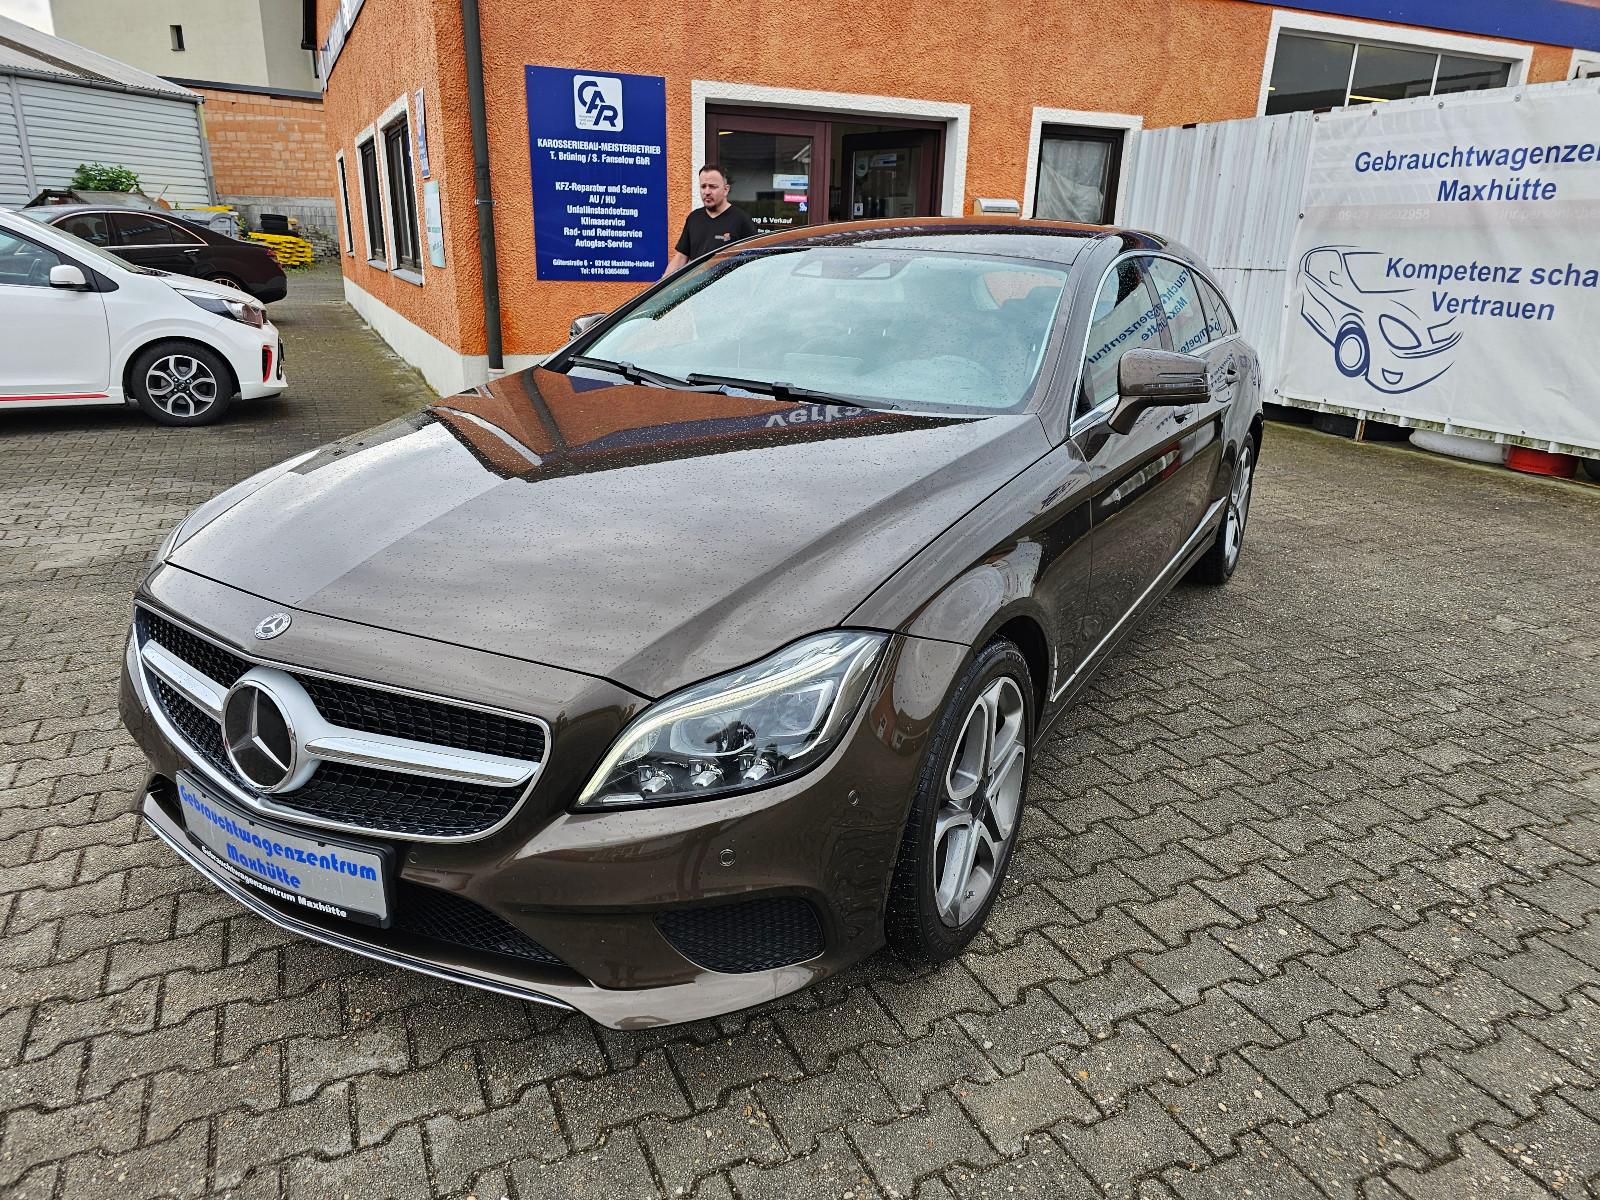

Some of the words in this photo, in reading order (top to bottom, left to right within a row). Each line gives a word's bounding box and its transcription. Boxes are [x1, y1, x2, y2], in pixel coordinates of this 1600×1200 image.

[578, 81, 618, 127] CAR
[537, 139, 661, 154] KAROSSERIEBAU-MEISTERBETRIEB
[558, 152, 586, 163] Brüning
[592, 154, 600, 163] S.
[602, 154, 634, 165] Fanselow
[635, 156, 651, 166] GbR
[1354, 143, 1600, 173] Gebrauchtwagenze
[555, 182, 606, 193] KFZ-Reparatur
[607, 184, 621, 193] und
[622, 185, 647, 194] Service
[1437, 177, 1557, 202] Maxhütte
[589, 195, 599, 203] AU
[605, 195, 616, 204] HU
[567, 205, 638, 217] Unfallinstandsetzung
[581, 217, 625, 226] Klimaservice
[769, 217, 793, 225] Verkauf
[564, 227, 580, 235] Rad-
[597, 229, 642, 238] Reifenservice
[575, 239, 632, 248] Autoglas-Service
[1385, 257, 1522, 285] Kompetenz
[1431, 291, 1556, 321] Vertrauen
[180, 785, 377, 881] Gebrauchtwagenzentrum
[226, 843, 301, 889] Maxhütte
[201, 846, 296, 903] Gebrauchtwagenzentrum
[298, 895, 347, 918] Maxhütte
